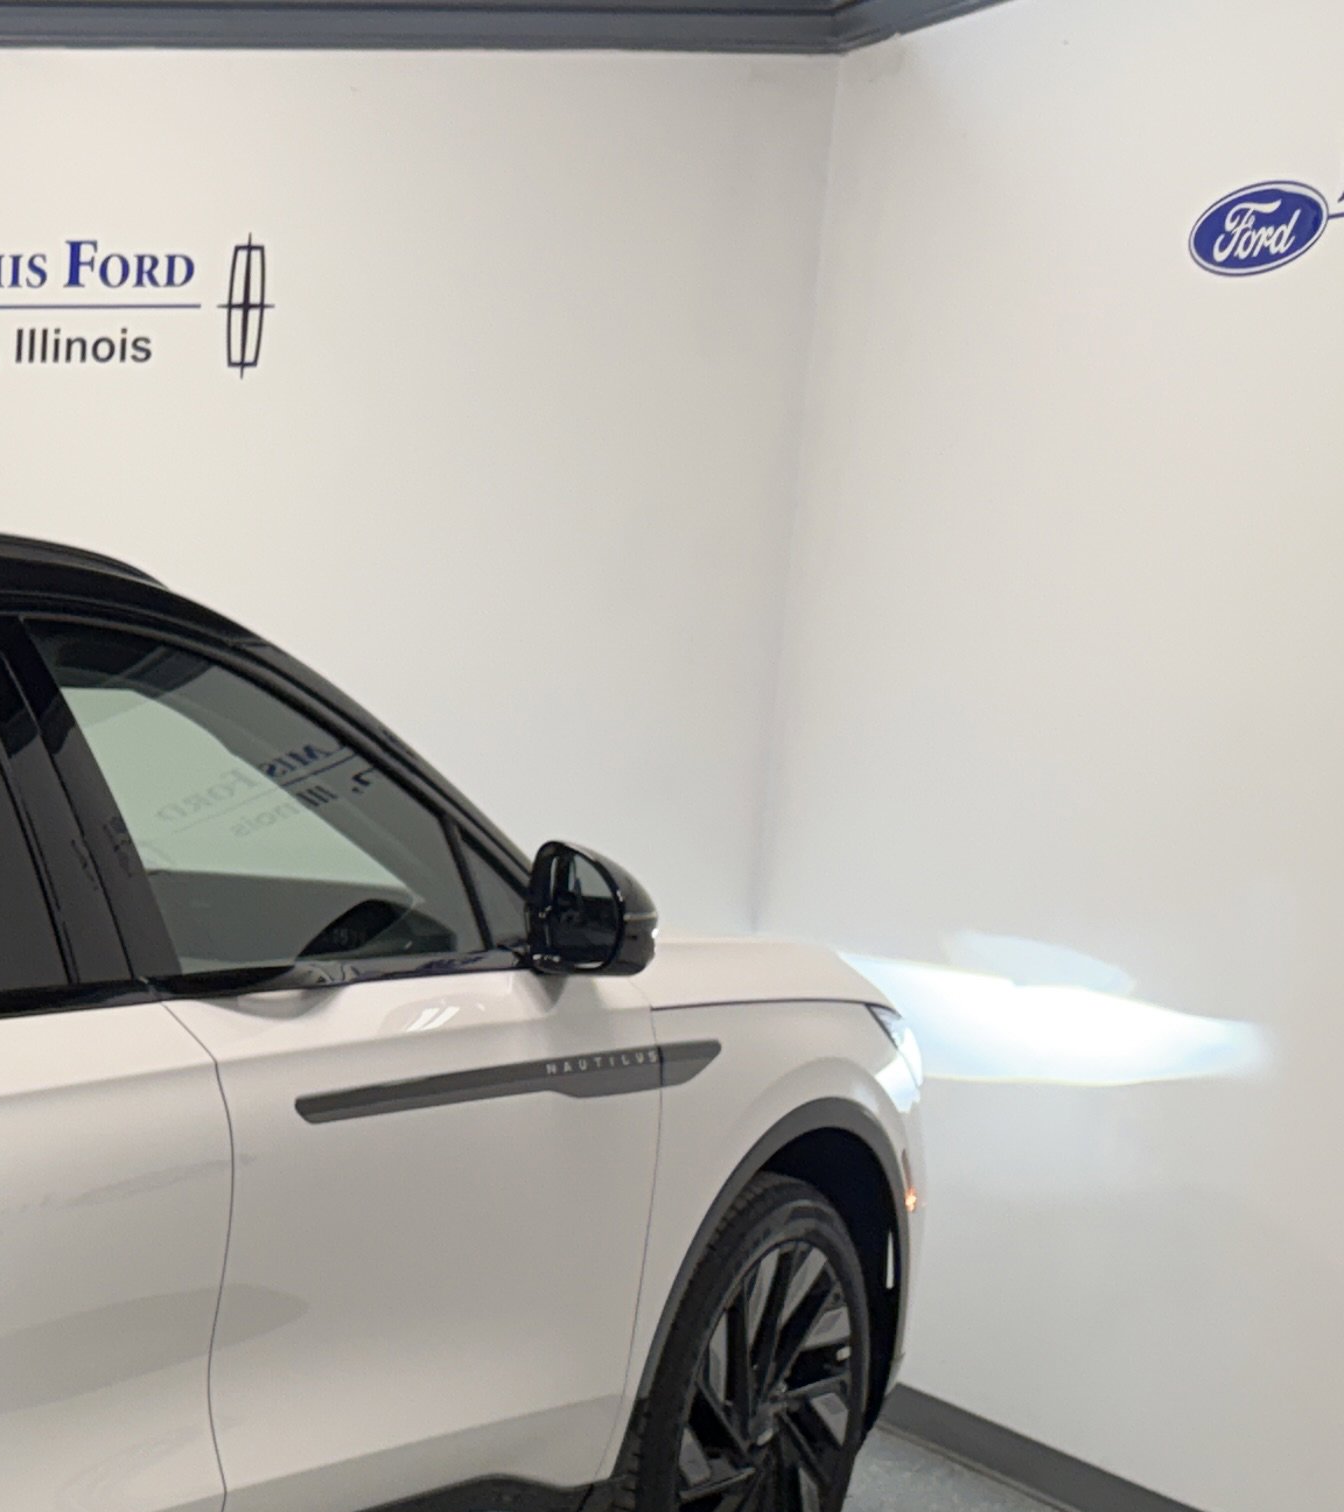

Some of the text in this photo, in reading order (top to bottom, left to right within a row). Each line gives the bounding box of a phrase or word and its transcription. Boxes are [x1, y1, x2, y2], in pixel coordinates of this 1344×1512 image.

[1213, 199, 1301, 263] Ford
[64, 239, 195, 289] FORD
[14, 327, 153, 364] Illinois
[547, 1050, 658, 1076] NAUTILUS
